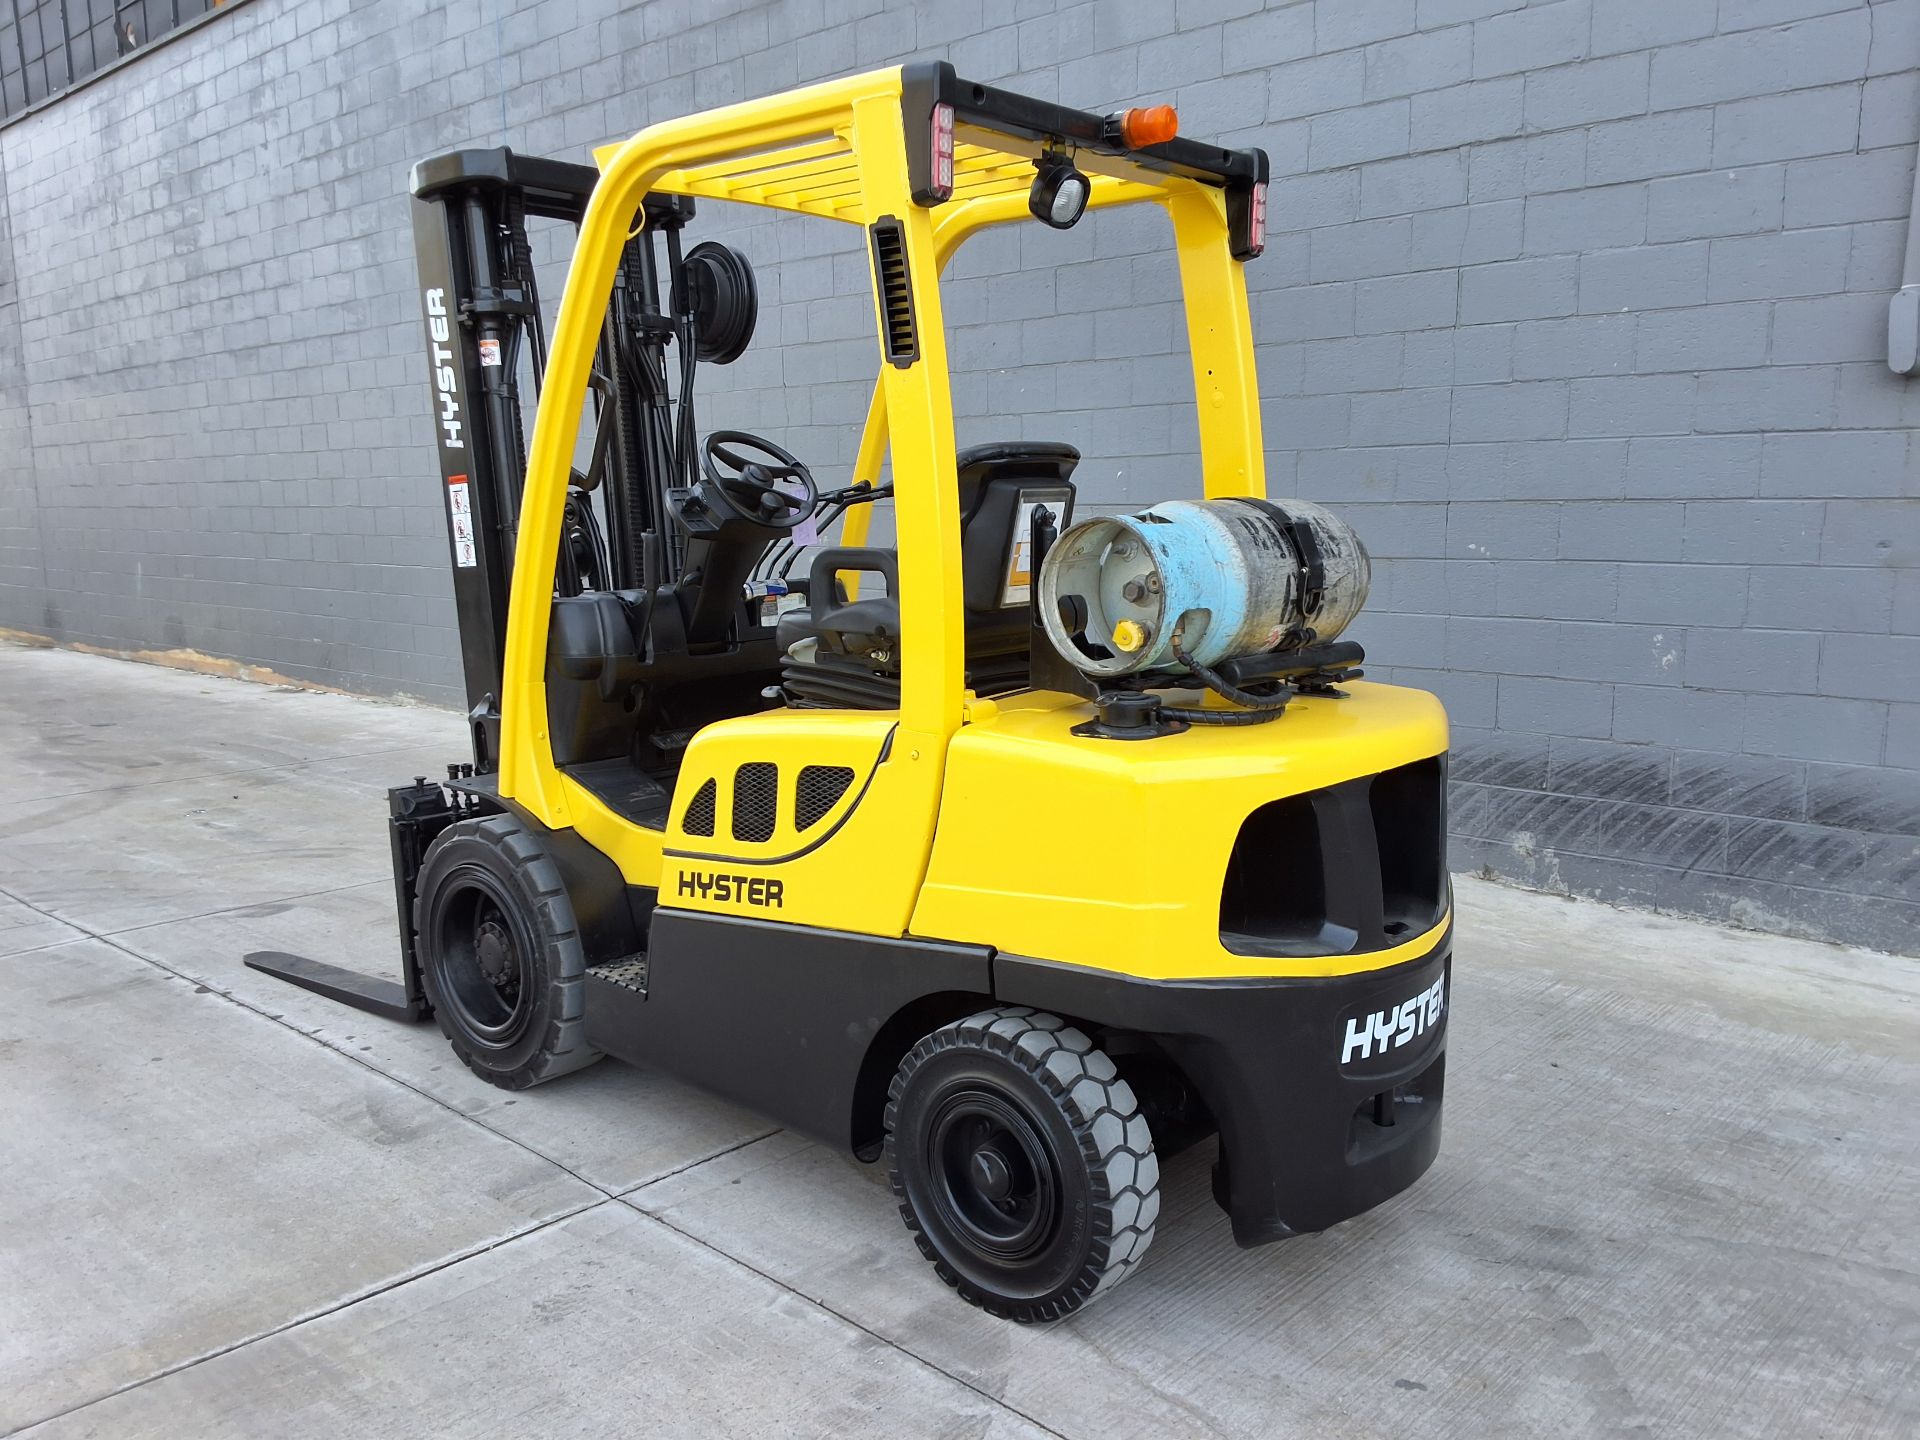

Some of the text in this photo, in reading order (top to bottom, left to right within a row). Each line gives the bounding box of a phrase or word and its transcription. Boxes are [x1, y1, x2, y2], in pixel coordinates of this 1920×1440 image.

[427, 288, 464, 448] HYSTER
[678, 870, 783, 908] HYSTER
[1341, 969, 1445, 1064] HYSTER
